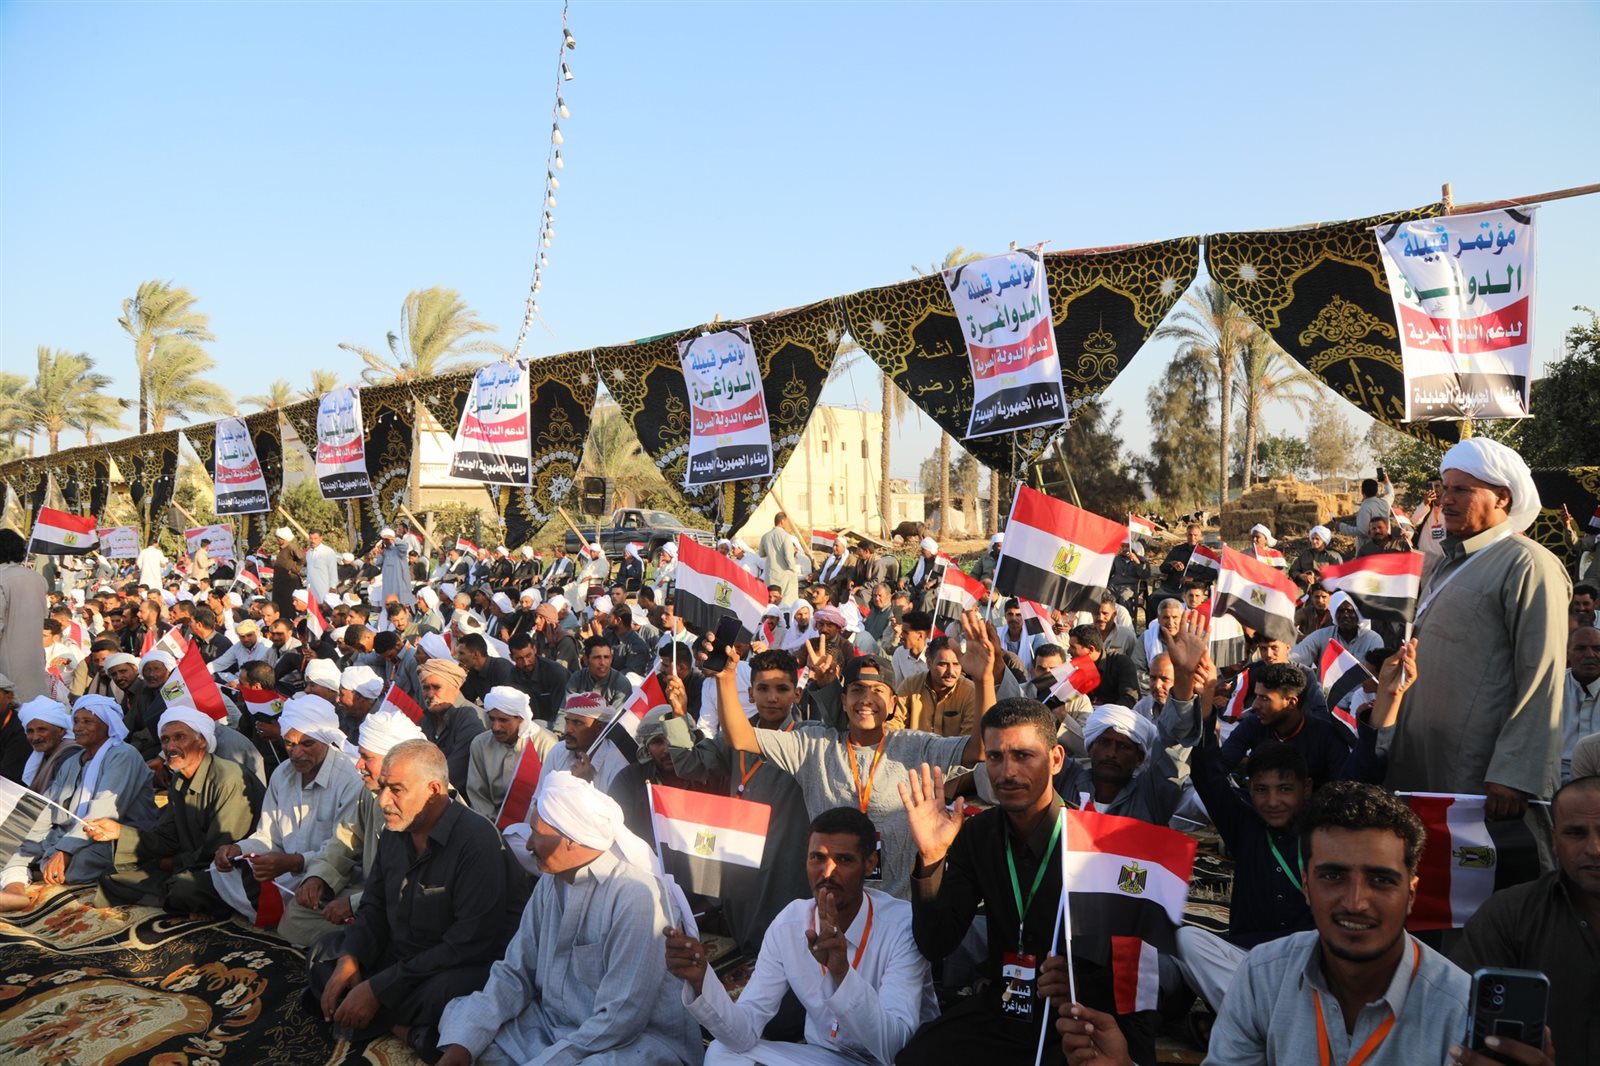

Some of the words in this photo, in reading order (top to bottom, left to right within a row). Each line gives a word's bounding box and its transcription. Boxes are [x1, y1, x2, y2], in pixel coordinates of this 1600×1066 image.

[1399, 225, 1450, 262] قبيلة
[1453, 221, 1517, 258] مؤتمر
[962, 271, 993, 304] قبيلة
[998, 262, 1035, 297] مؤتمر
[1398, 263, 1522, 307] الدورة
[967, 292, 1043, 342] الدواغرة
[1486, 321, 1523, 344] لدعم
[916, 339, 970, 360] راشة
[997, 344, 1026, 366] الدولة
[691, 349, 716, 375] قبيلة
[692, 369, 756, 406] الدواغرة
[1037, 391, 1059, 412] وبناء
[716, 412, 742, 428] الدولة
[742, 407, 763, 427] لدعم
[504, 424, 526, 438] لدعم
[716, 454, 750, 473] الجمهورية
[750, 452, 768, 466] وبناء
